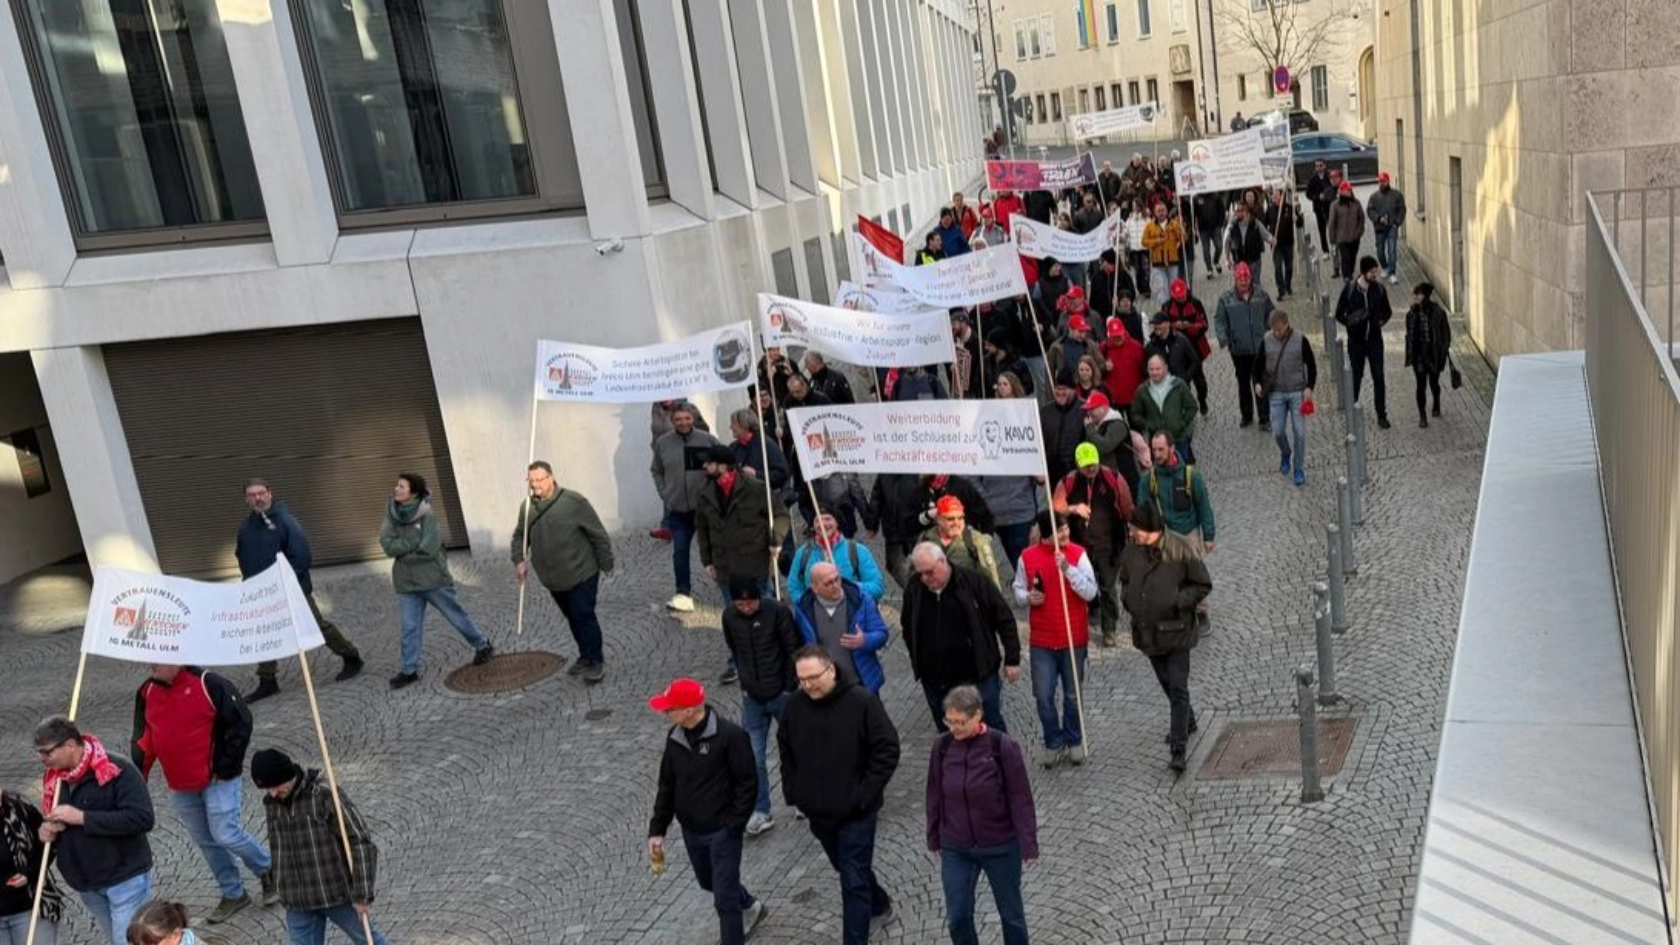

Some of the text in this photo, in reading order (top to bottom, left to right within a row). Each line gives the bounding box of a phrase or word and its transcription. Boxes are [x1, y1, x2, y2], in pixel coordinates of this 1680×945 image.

[801, 412, 864, 436] VERTRAUENSLEUTE
[887, 412, 961, 427] Weiterbildung
[873, 430, 977, 444] ist der Schlüssel zur
[874, 448, 978, 466] Fachkräftesicherung
[110, 586, 192, 617] VERTRAUENSLEUTE
[109, 636, 179, 652] IG METALL ULM
